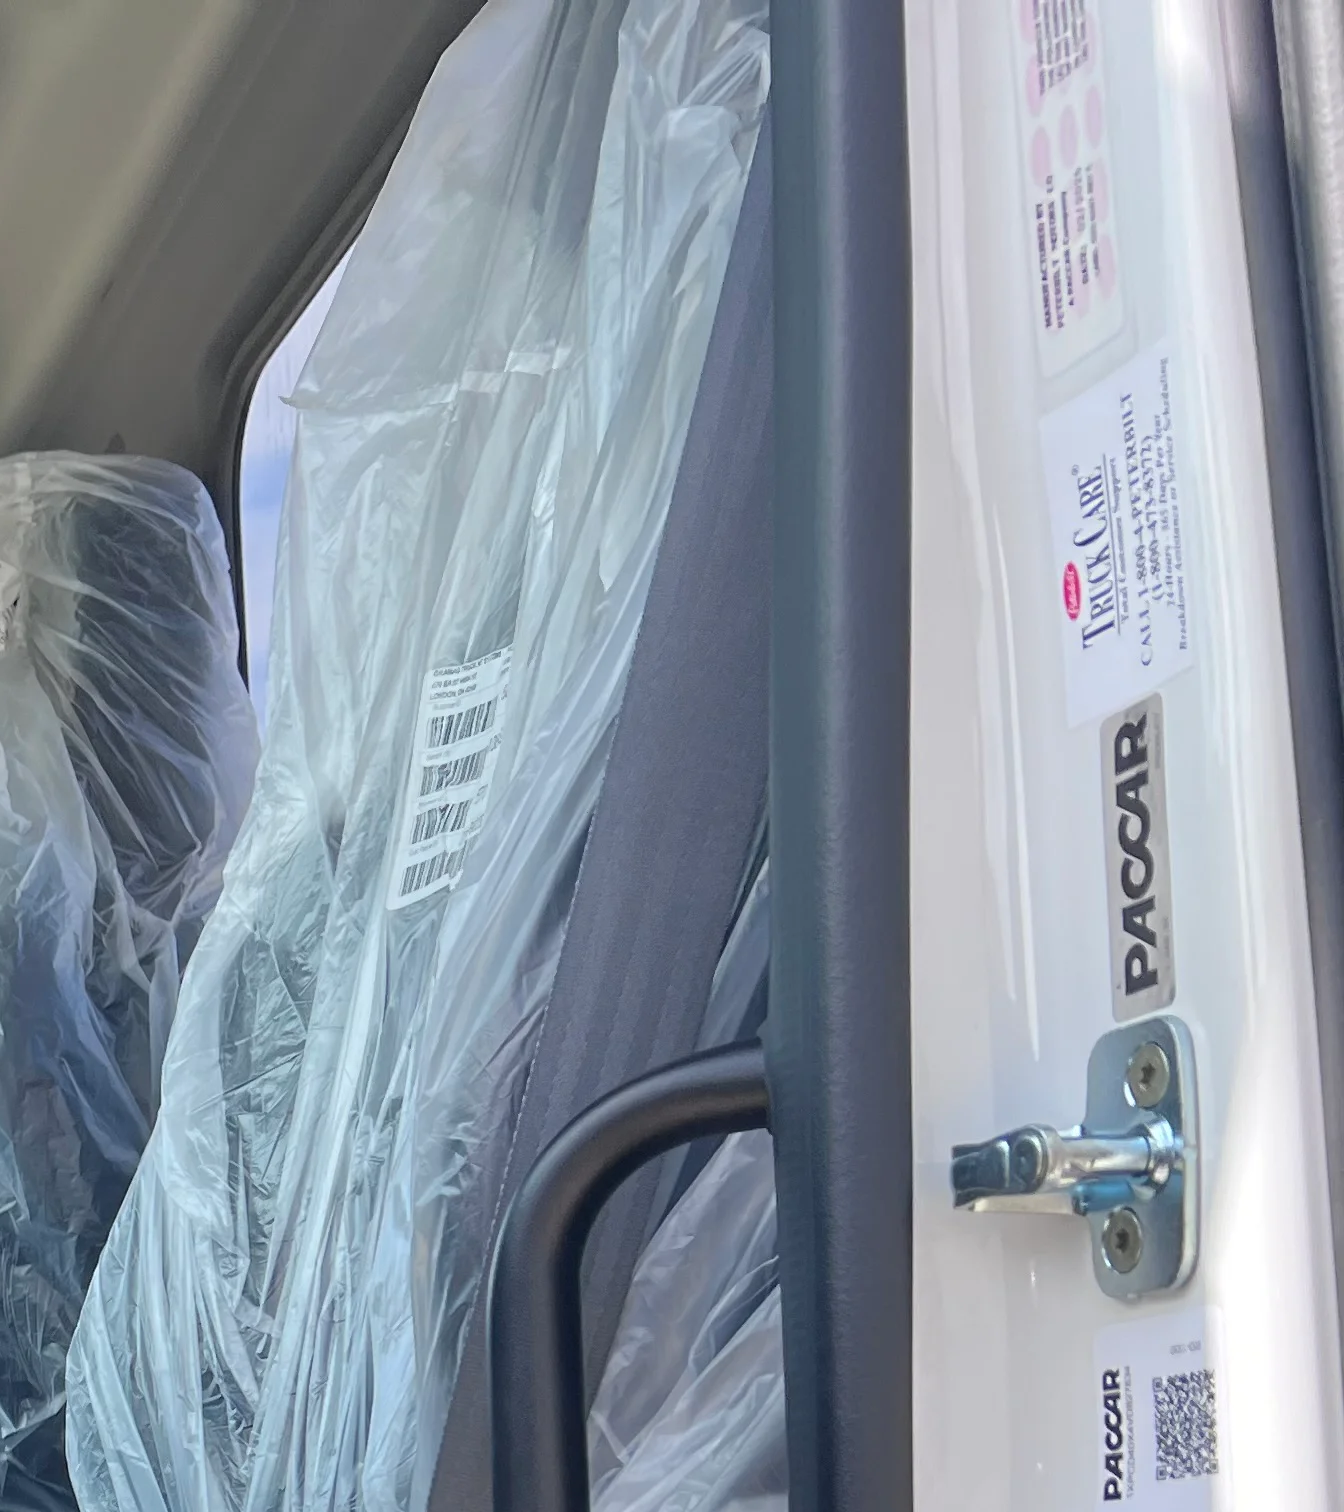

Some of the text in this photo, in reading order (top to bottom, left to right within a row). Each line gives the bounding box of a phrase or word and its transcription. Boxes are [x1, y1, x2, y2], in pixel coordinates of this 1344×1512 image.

[1082, 544, 1115, 650] TRUCK
[1114, 712, 1159, 996] PACCAR
[1103, 1368, 1123, 1501] PACCAR
